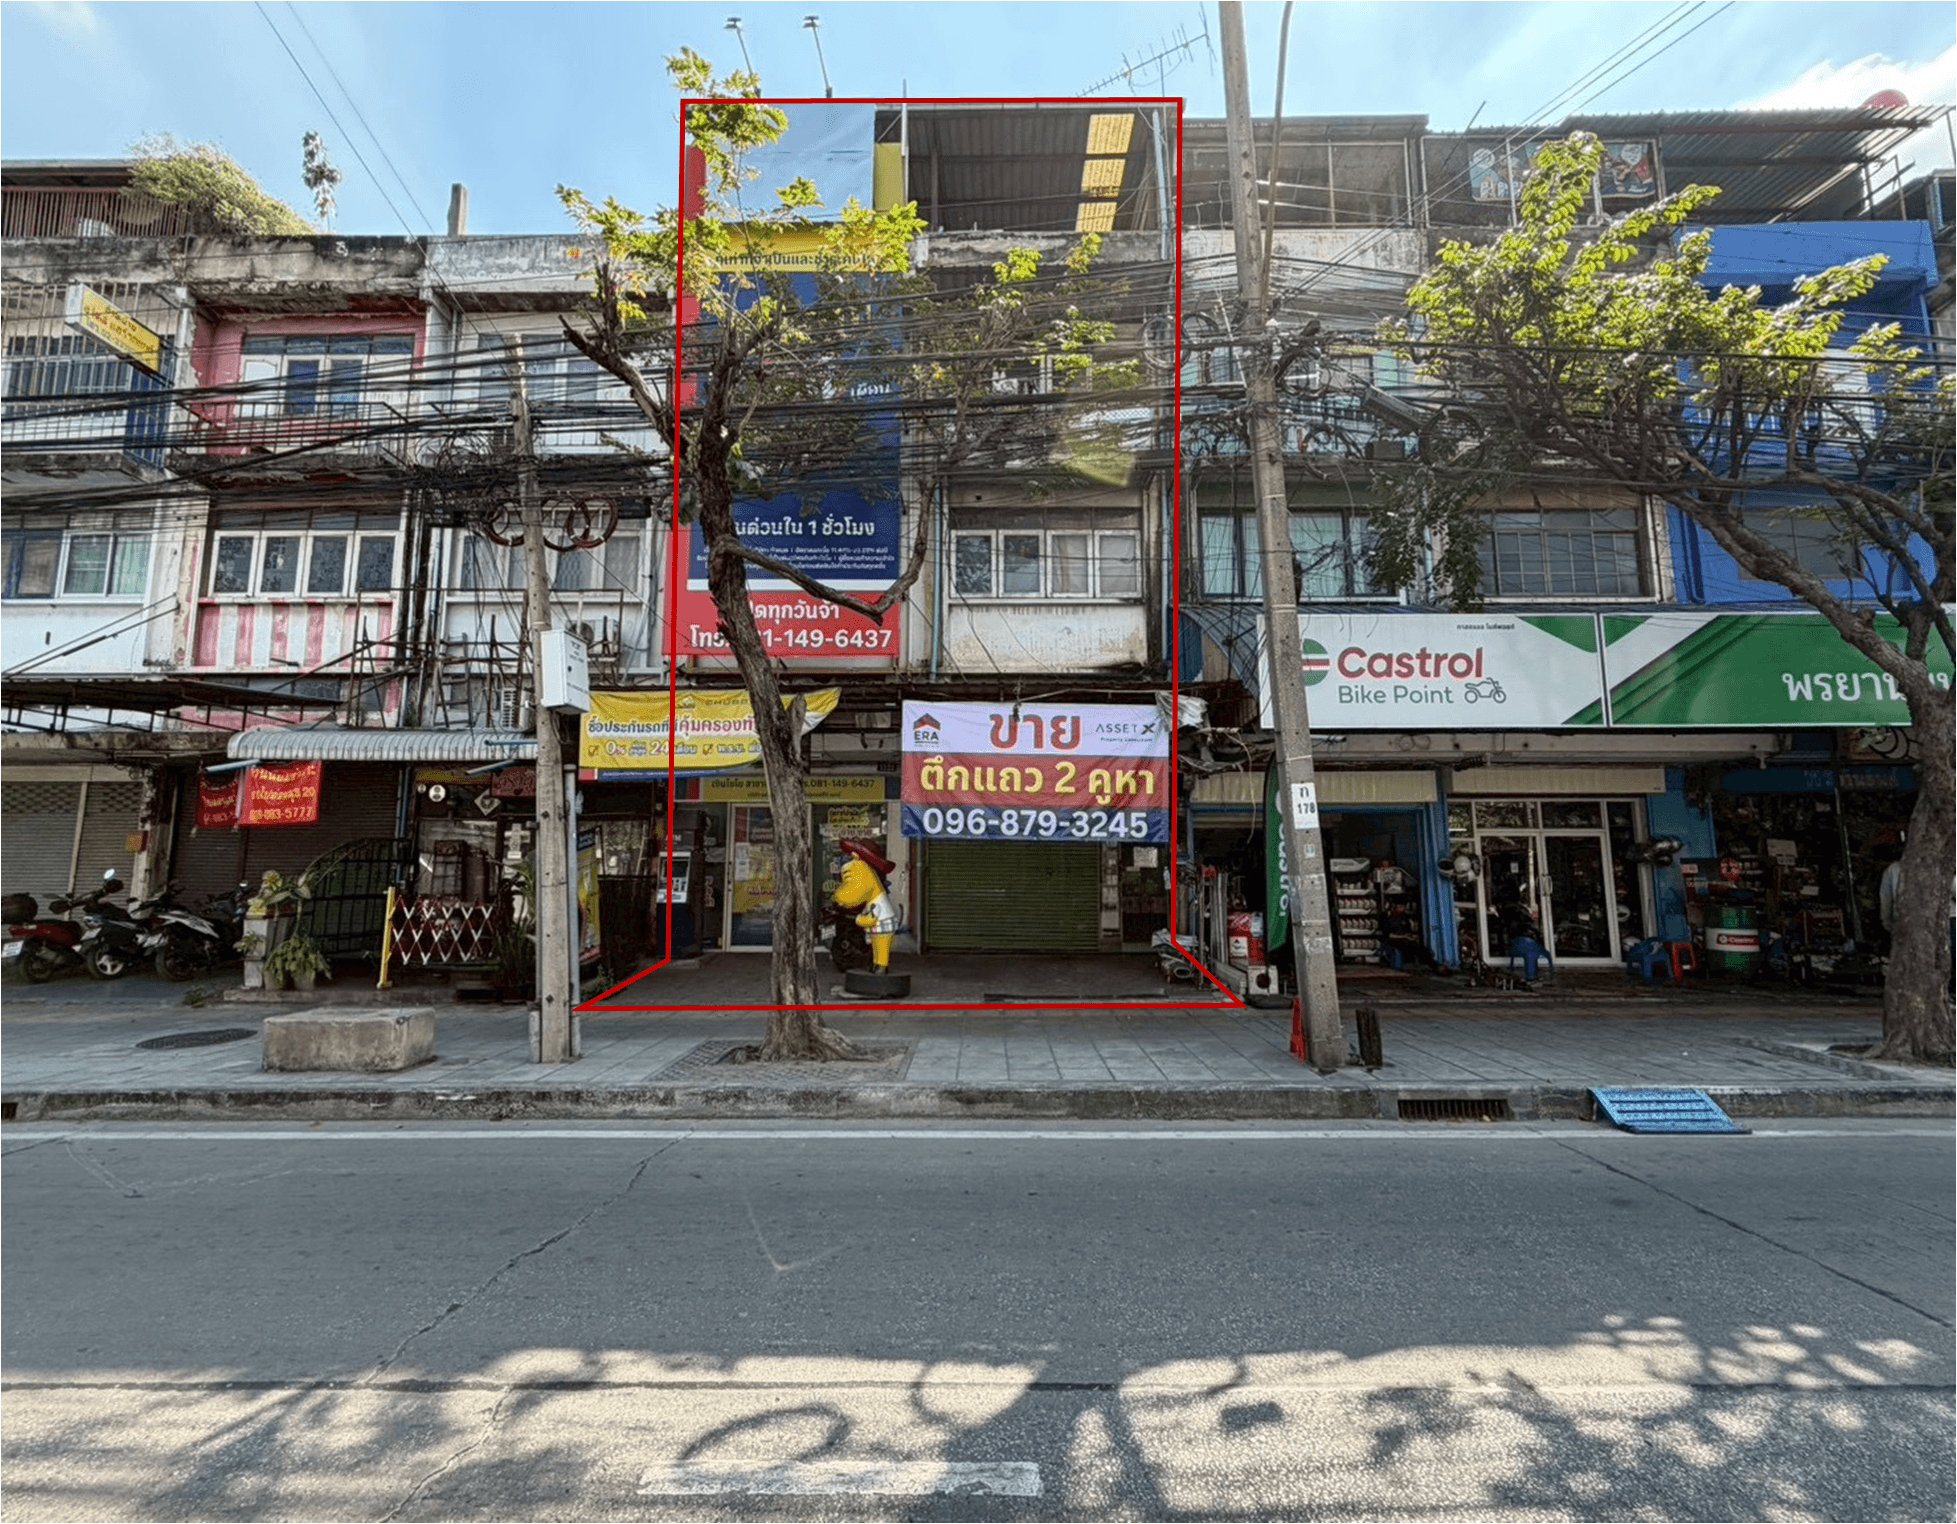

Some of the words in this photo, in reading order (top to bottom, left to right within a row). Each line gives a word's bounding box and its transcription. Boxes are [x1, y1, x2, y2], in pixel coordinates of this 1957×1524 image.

[735, 516, 803, 536] นด่วนใน
[808, 520, 817, 536] 1
[822, 513, 875, 536] ชั่วโมง
[751, 599, 840, 625] ดทุกวันจ้า
[1337, 646, 1484, 679] Castrol
[1339, 684, 1387, 704] Bike
[1394, 684, 1454, 704] Point
[913, 730, 940, 741] ERA
[989, 713, 1082, 750] ขาย
[1095, 722, 1138, 734] ASSET
[920, 756, 1044, 793] ตึกแถว
[1054, 760, 1077, 794] 2
[1088, 768, 1155, 806] คูหา
[1297, 802, 1316, 814] 178
[922, 807, 1148, 838] 096-879-3245
